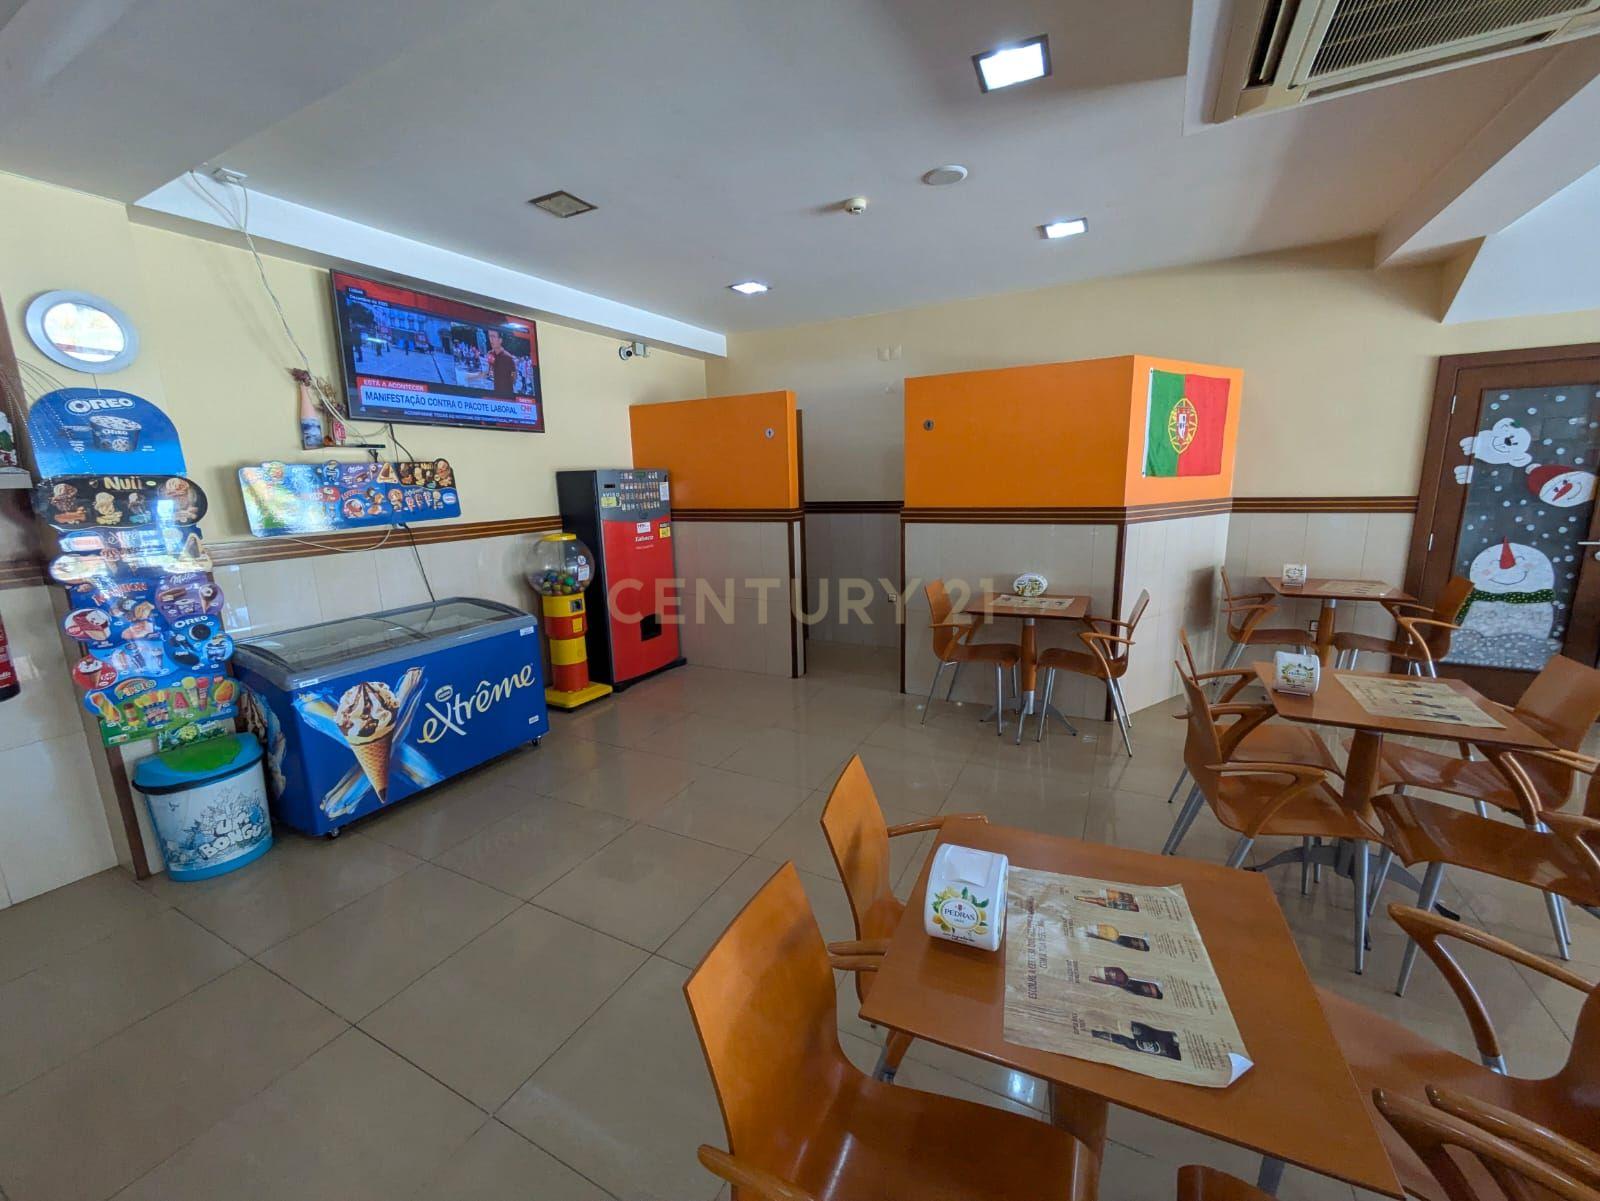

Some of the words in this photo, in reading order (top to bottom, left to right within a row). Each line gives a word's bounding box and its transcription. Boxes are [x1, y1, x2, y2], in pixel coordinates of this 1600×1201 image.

[67, 397, 134, 413] OREO
[365, 390, 426, 406] MANIFESTAÇÃO
[427, 397, 457, 409] CONTRA
[457, 401, 463, 409] O
[464, 402, 489, 412] PACOTE
[490, 405, 518, 415] LABORAL
[175, 615, 209, 629] OREO
[944, 908, 976, 921] PEDRAS
